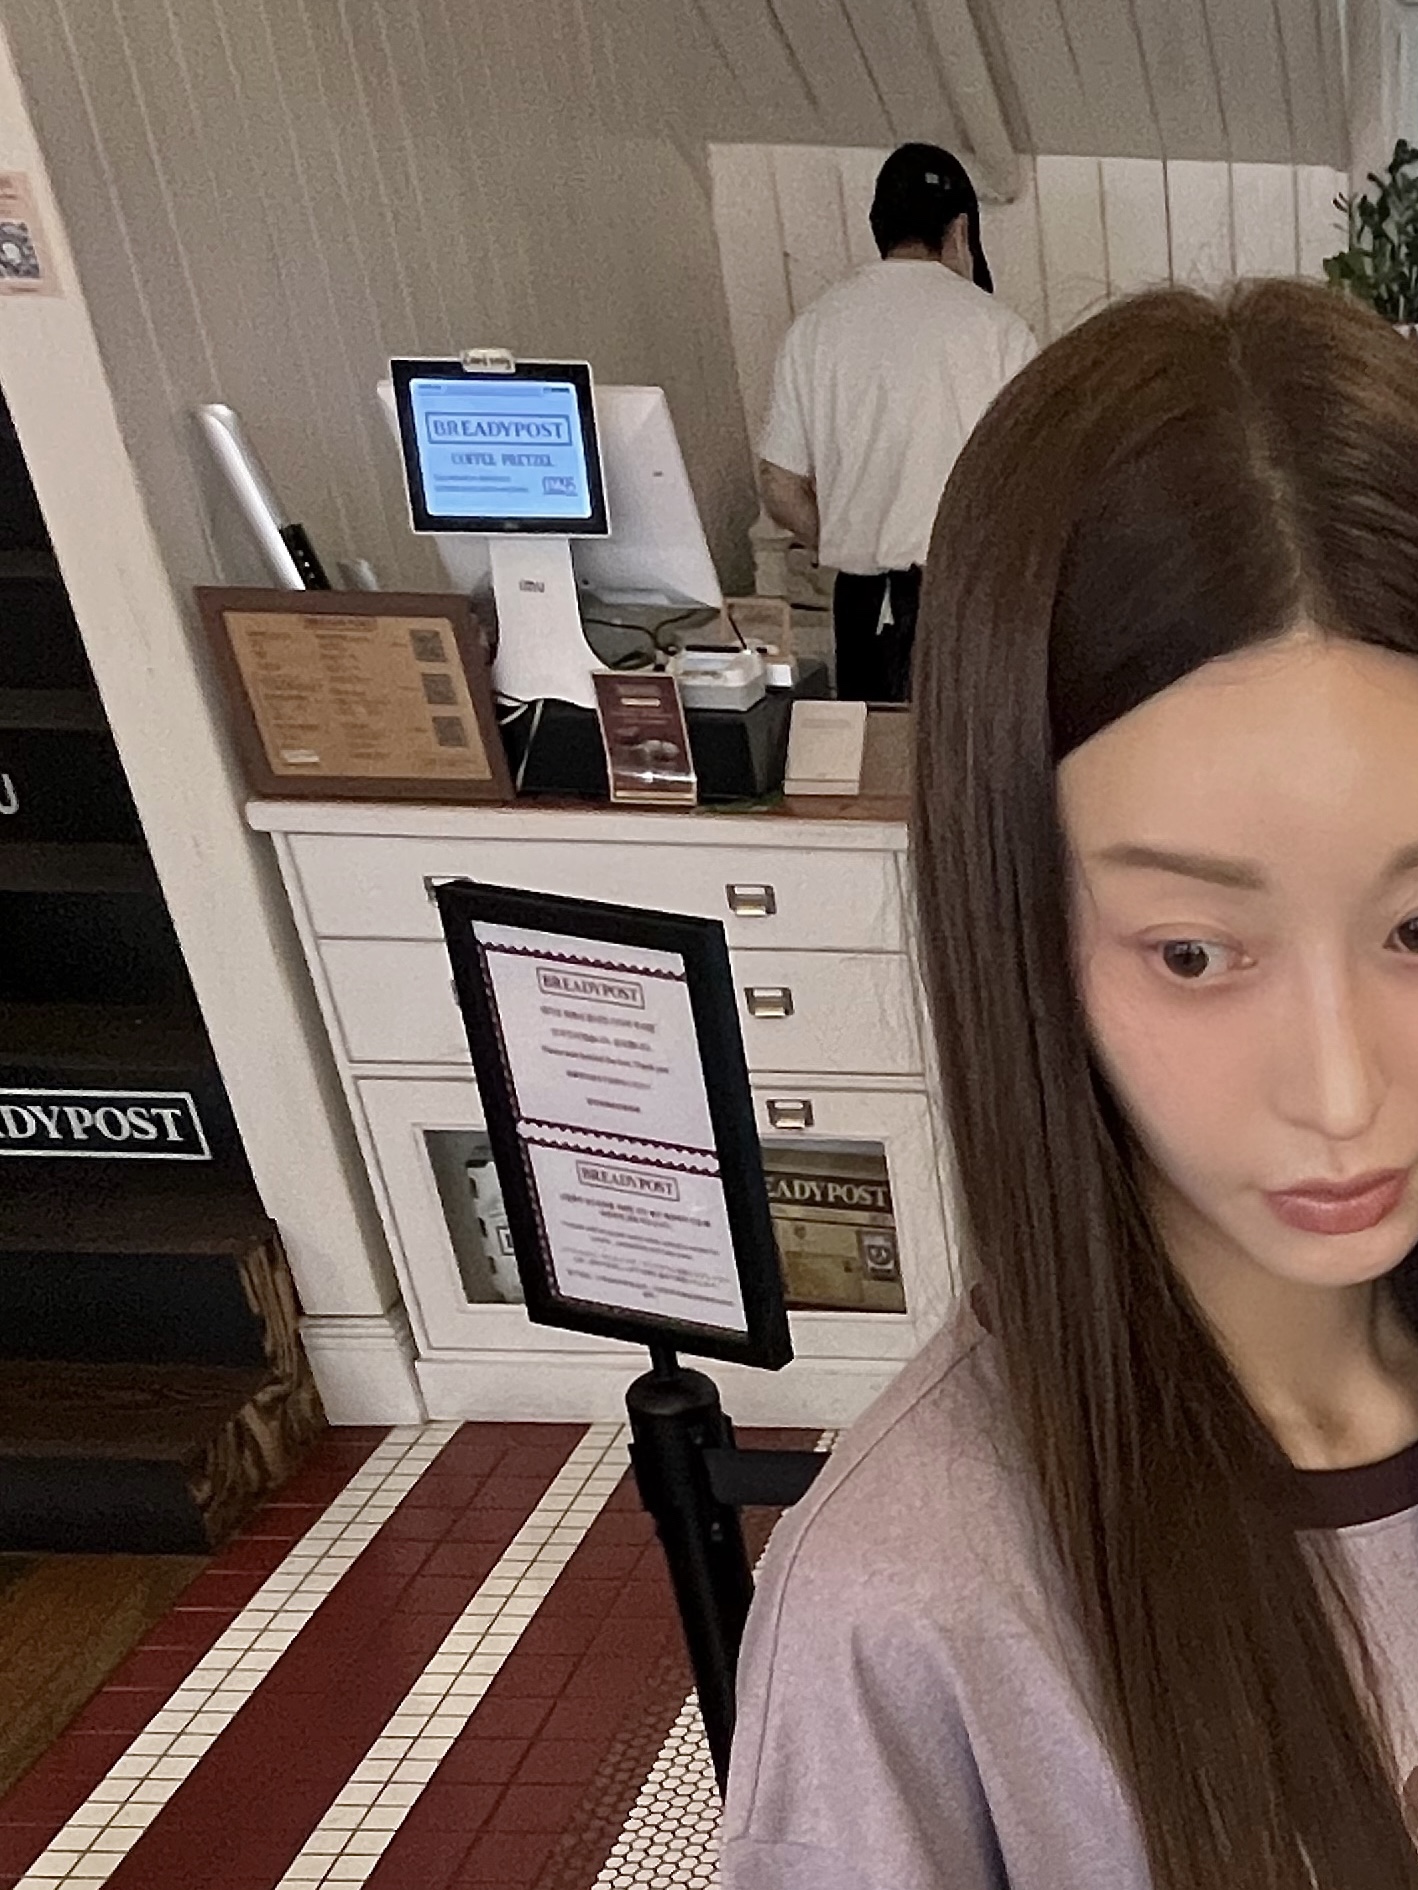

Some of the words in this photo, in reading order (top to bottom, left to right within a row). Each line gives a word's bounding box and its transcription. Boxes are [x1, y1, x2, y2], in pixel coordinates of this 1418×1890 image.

[433, 419, 563, 440] BREADYPOST
[543, 974, 638, 1002] BREADYPOST
[580, 1167, 673, 1196] BREADYPOST
